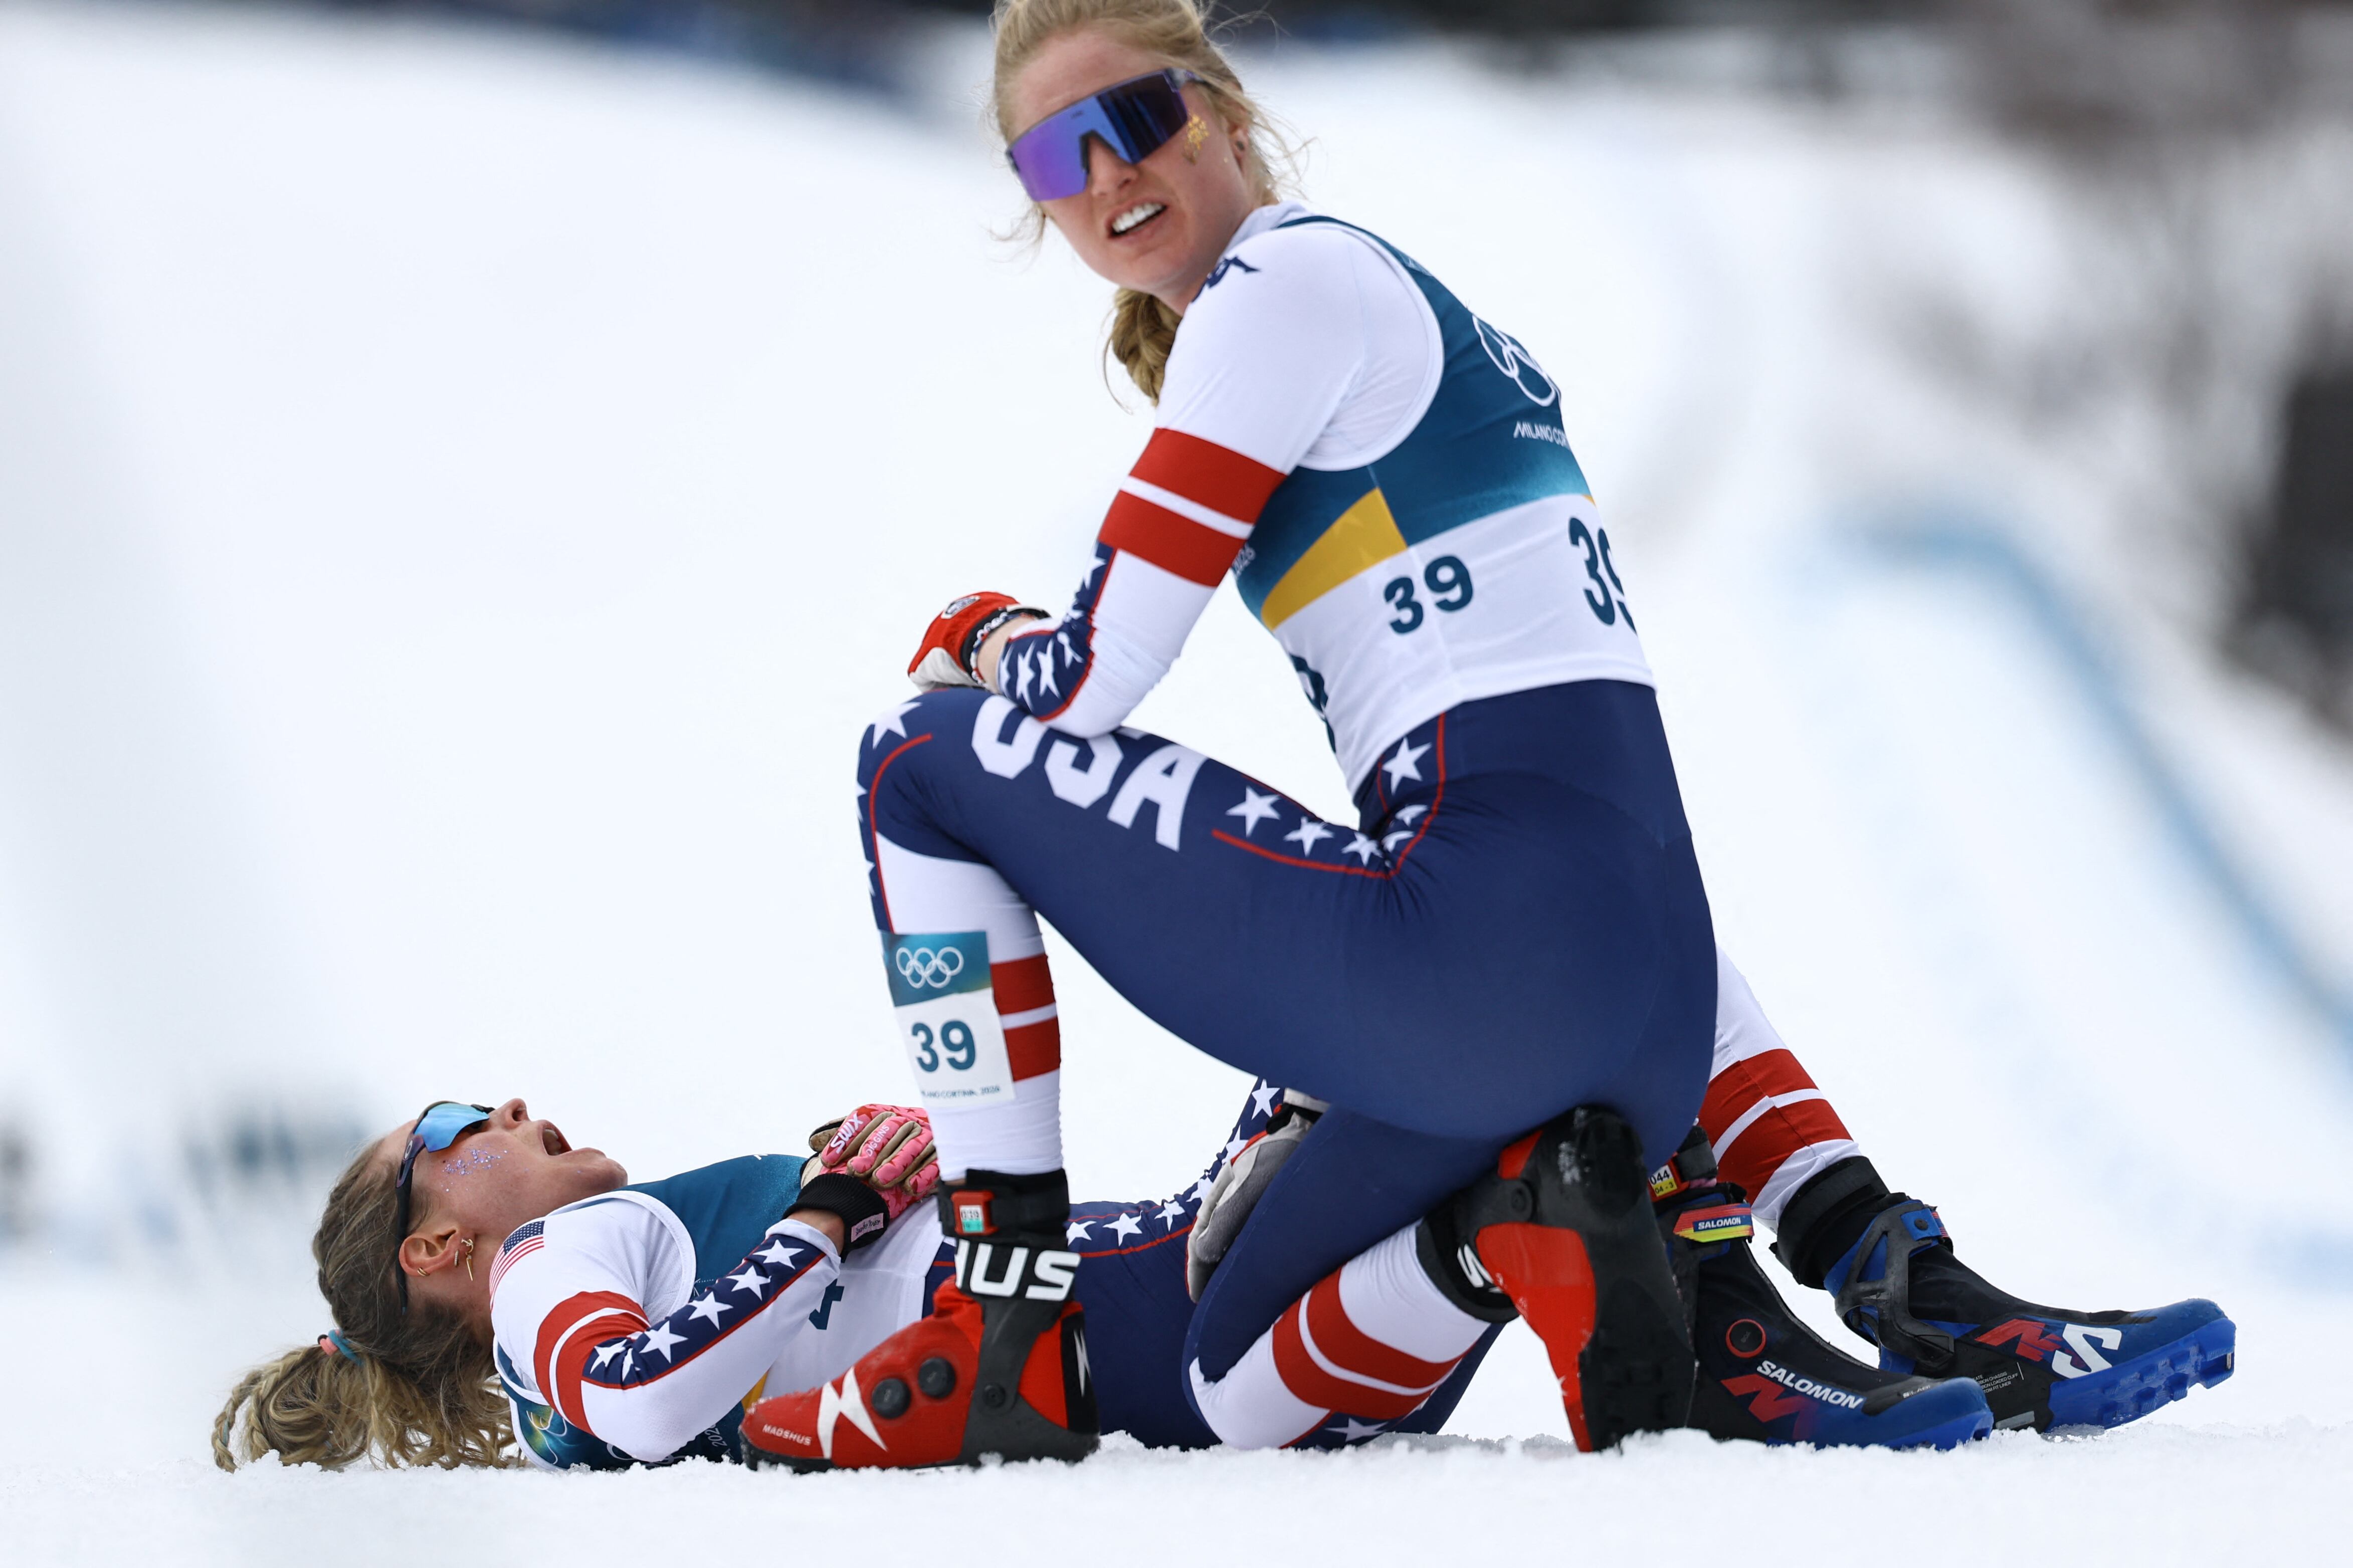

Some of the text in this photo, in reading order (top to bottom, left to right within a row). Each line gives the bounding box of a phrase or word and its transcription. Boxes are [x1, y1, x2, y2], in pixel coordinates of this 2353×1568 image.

[1513, 421, 1553, 443] MILANO
[1384, 555, 1473, 635] 39
[971, 695, 1209, 852] USA
[910, 1019, 976, 1073] 39
[830, 1113, 863, 1154] SWIX
[866, 1125, 889, 1157] DIGGINS
[1650, 1170, 1670, 1185] 044
[1698, 1216, 1741, 1230] SALOMON
[1756, 1360, 1864, 1409] SALOMON
[1991, 1377, 2007, 1387] LOADED
[762, 1424, 812, 1446] MADSHUS
